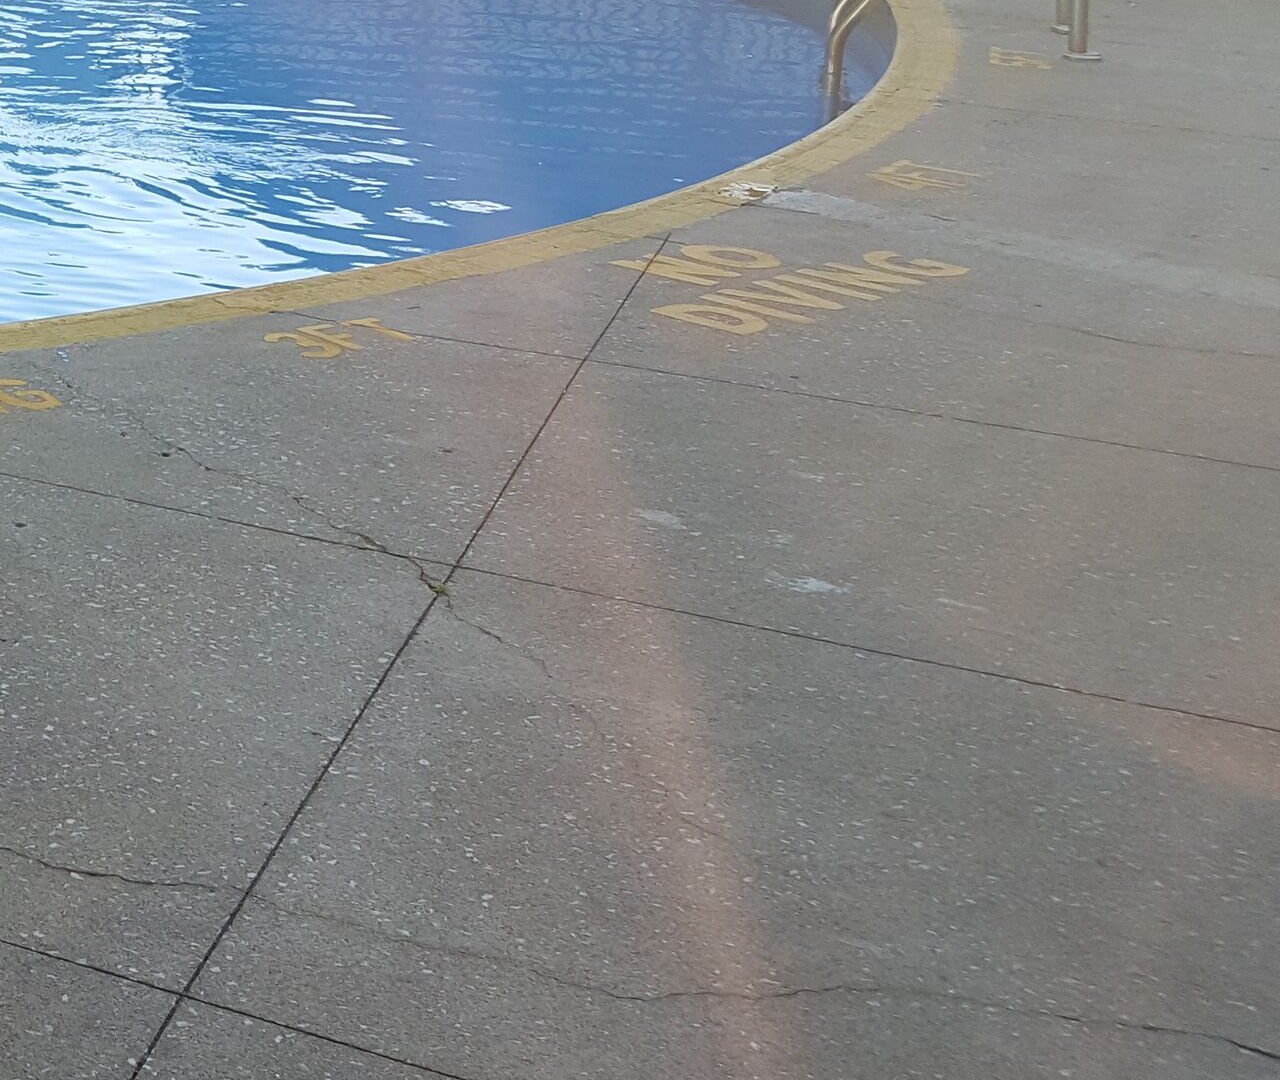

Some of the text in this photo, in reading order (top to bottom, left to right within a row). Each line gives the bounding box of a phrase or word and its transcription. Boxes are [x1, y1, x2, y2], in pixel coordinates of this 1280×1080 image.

[608, 245, 782, 287] NO
[650, 251, 973, 336] DIVING
[263, 317, 418, 359] 3FT
